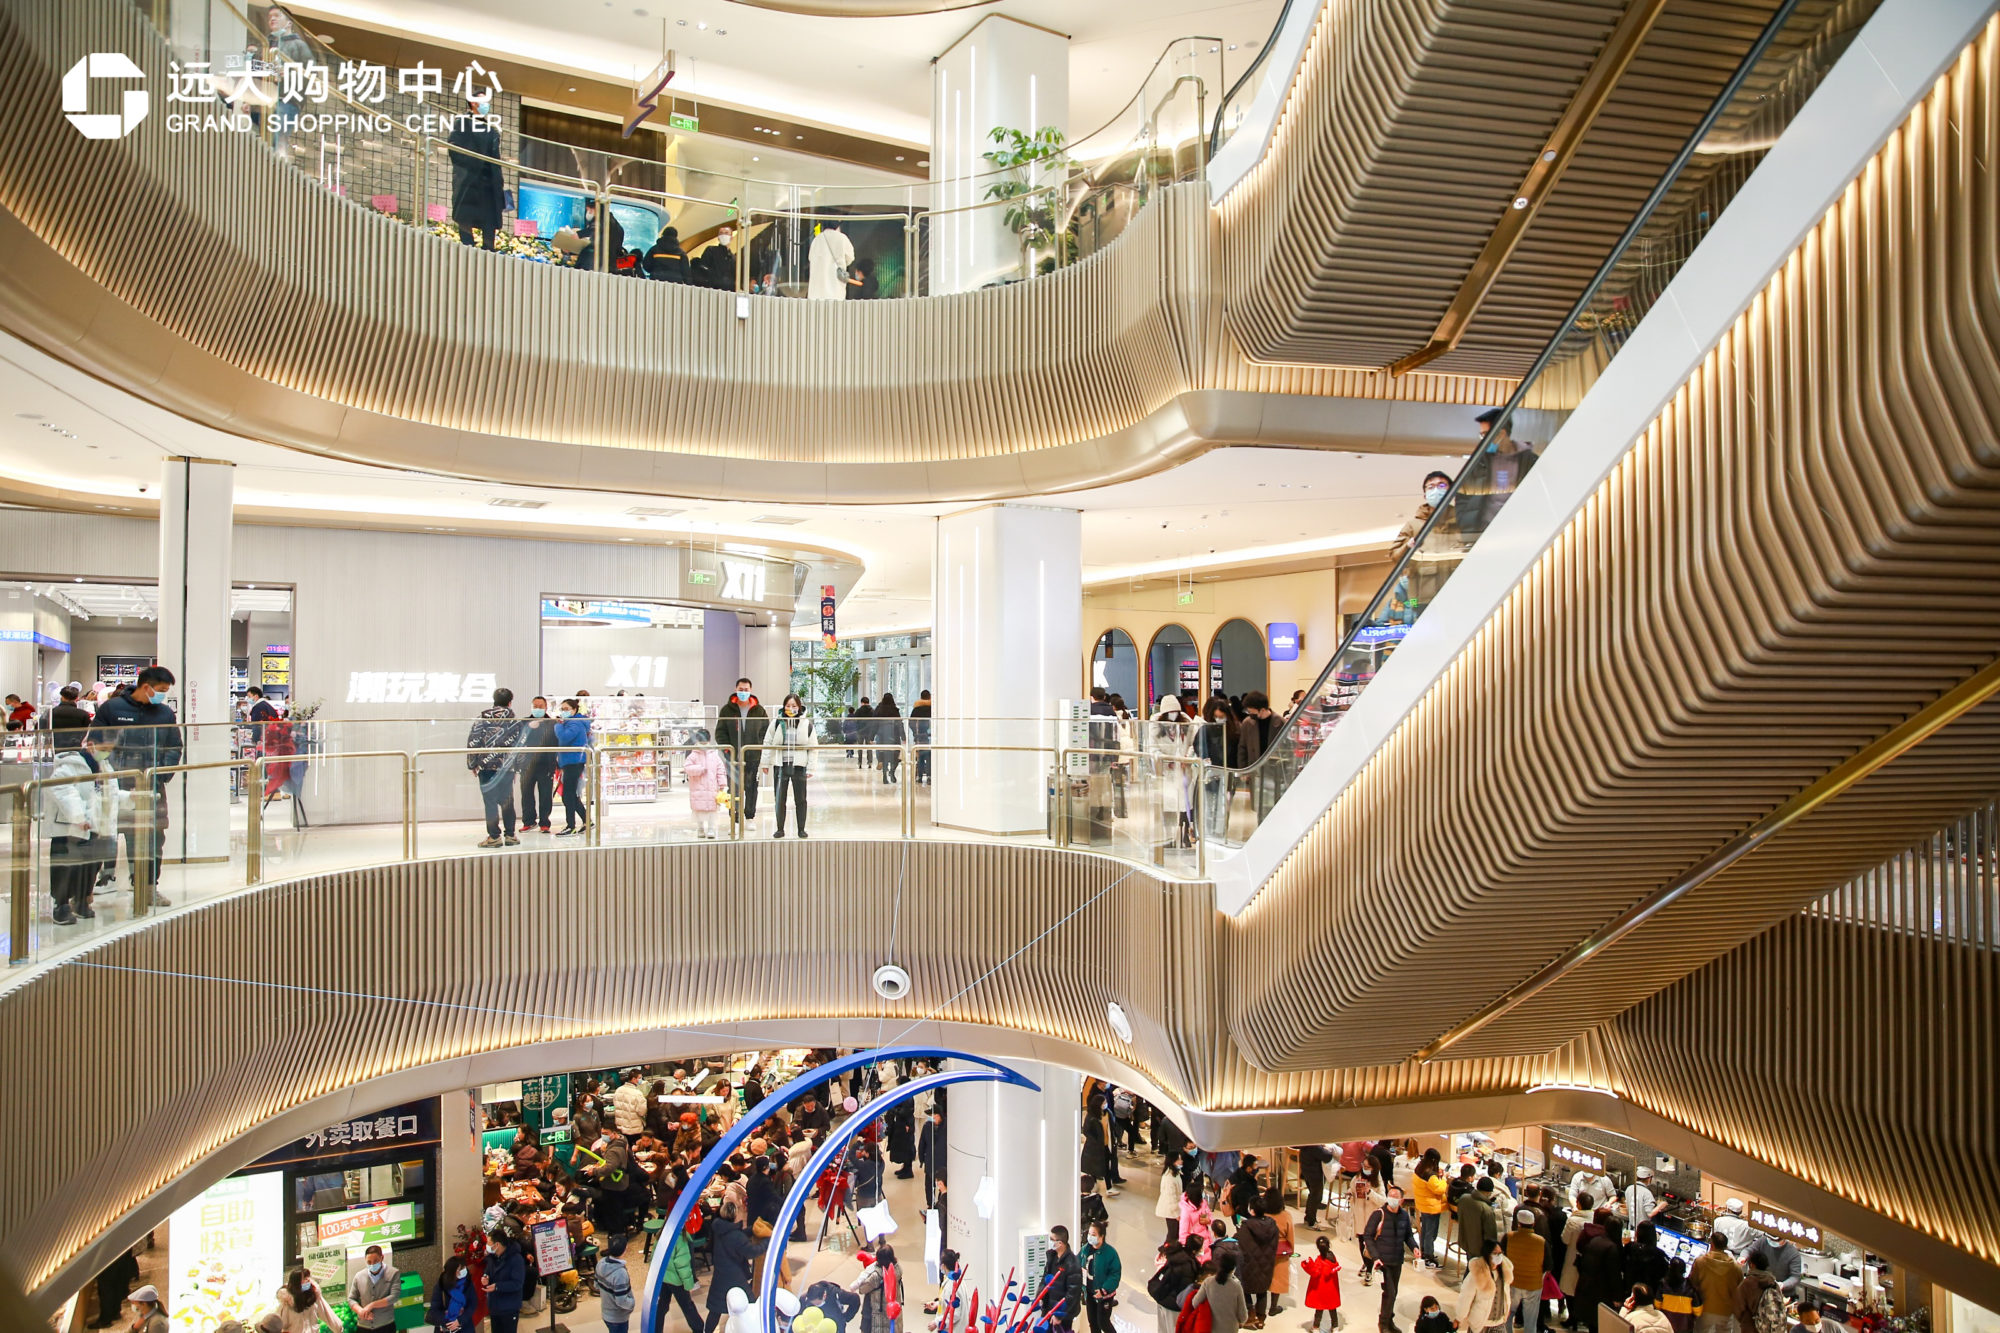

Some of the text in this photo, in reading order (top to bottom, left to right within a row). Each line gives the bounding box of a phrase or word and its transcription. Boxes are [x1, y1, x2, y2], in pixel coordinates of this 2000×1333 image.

[605, 655, 669, 688] X11
[305, 1115, 418, 1148] 外卖取餐口
[200, 1199, 255, 1228] 自助
[320, 1212, 380, 1238] 100元电子卡
[370, 1223, 402, 1237] 一等奖
[308, 1249, 341, 1261] 储值优惠
